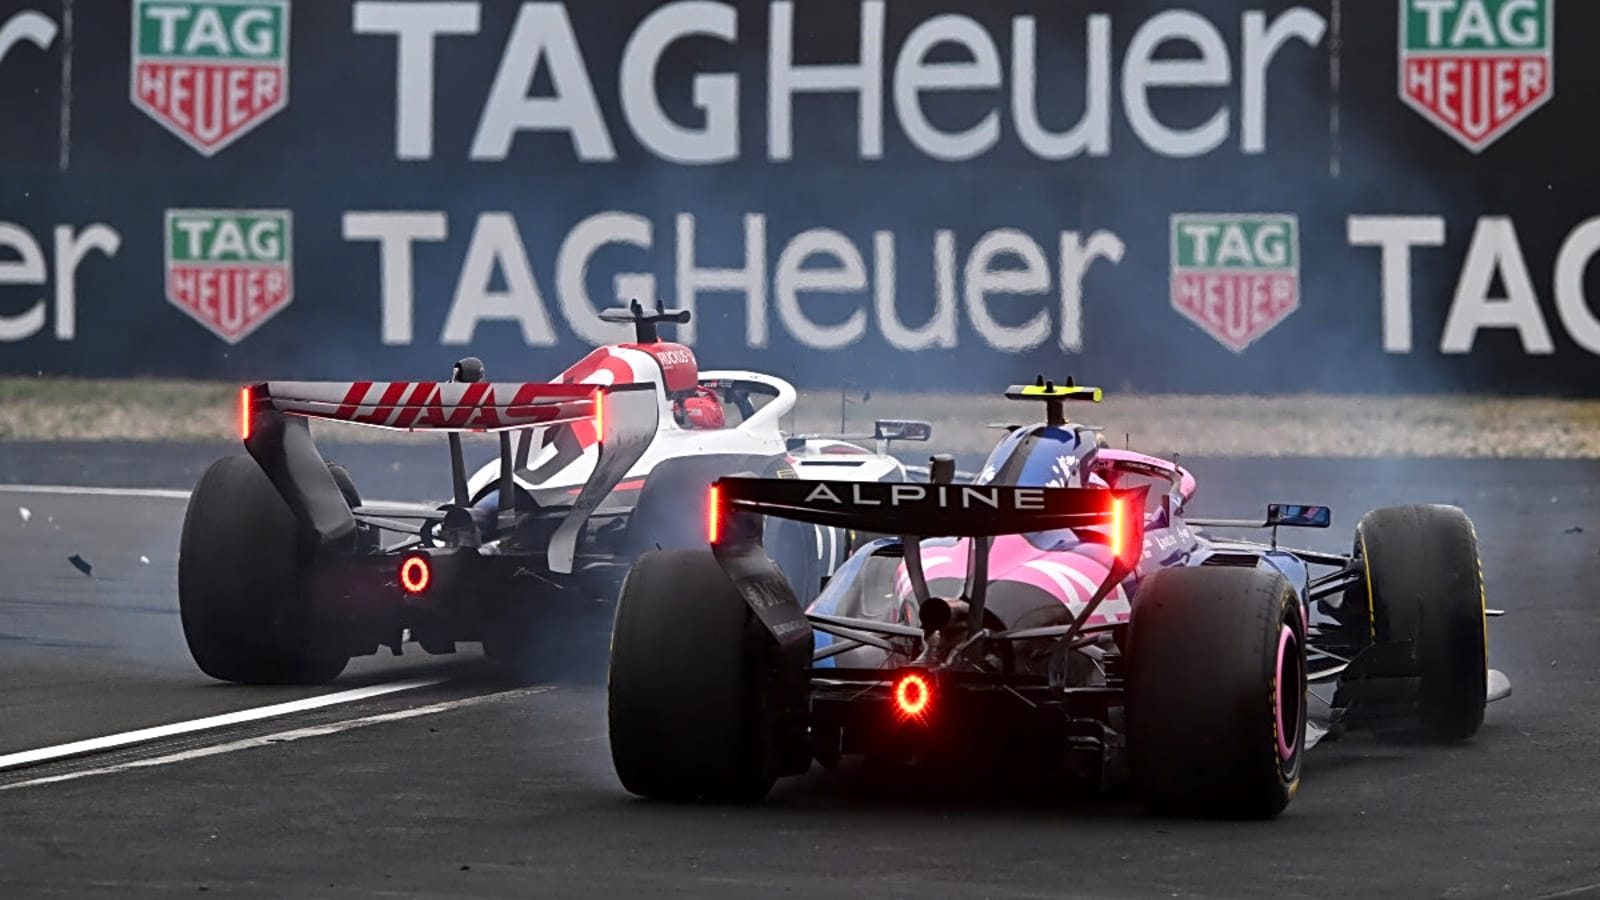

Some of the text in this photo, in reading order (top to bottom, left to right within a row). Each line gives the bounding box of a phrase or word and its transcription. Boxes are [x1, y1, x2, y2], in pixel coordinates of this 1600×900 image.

[145, 7, 274, 54] TAG
[1414, 0, 1538, 45] TAG
[141, 66, 277, 140] HEUER
[1408, 60, 1543, 137] HEUER
[177, 220, 280, 258] TAG
[1184, 225, 1287, 264] TAG
[174, 271, 283, 329] HEUER
[1180, 276, 1293, 339] HEUER
[334, 381, 598, 428] HAAS
[804, 482, 1046, 510] ALPINE
